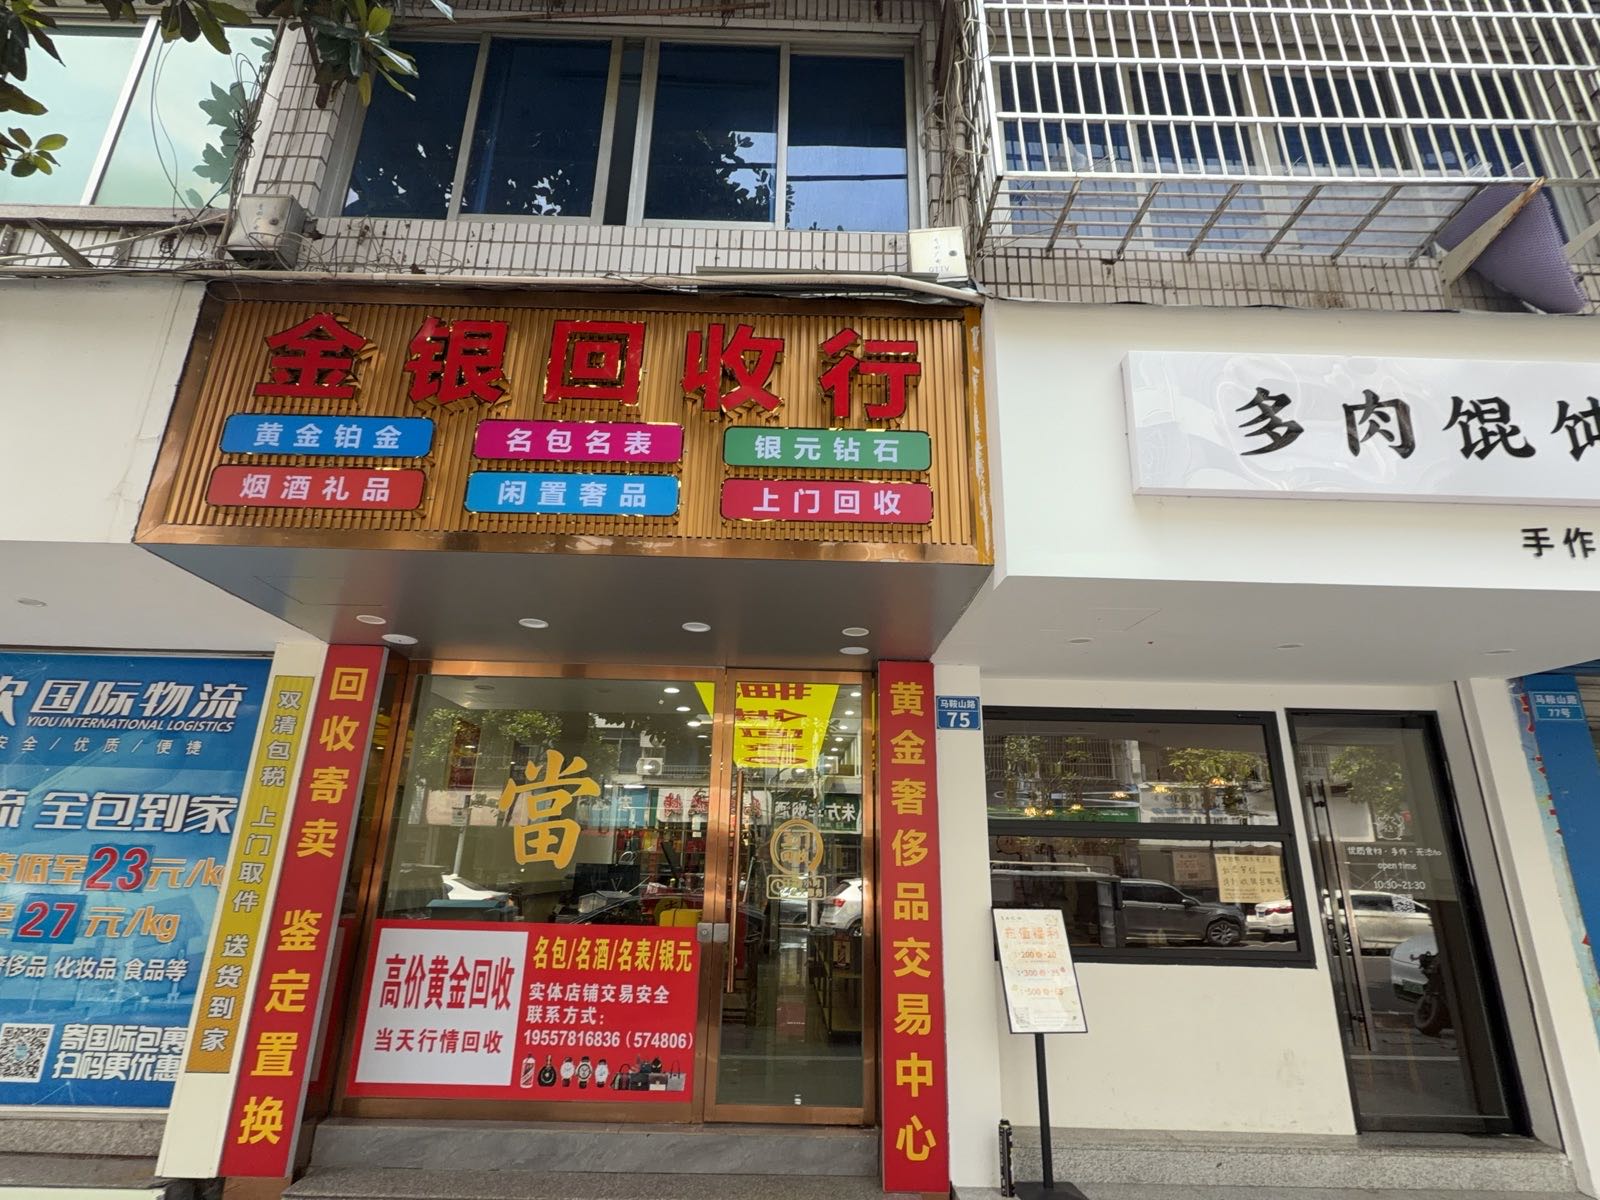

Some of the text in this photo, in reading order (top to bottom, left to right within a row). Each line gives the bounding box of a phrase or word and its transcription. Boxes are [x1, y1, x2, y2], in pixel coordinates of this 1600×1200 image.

[254, 312, 922, 420] 金银回收行
[253, 422, 402, 450] 黄金铂金
[505, 428, 652, 456] 名包名表
[755, 435, 900, 463] 银元钻石
[240, 473, 391, 503] 烟酒礼品
[498, 480, 647, 509] 闲置奢品
[753, 487, 901, 516] 上门回收
[940, 699, 976, 709] 马鞍山路
[1547, 707, 1571, 718] 77号
[26, 716, 235, 733] YIOU INTERNATIONAL LOGISTICS
[947, 711, 970, 728] 75
[34, 791, 239, 834] 全包到家
[498, 749, 601, 870] 當
[201, 689, 301, 1052] 双清包税 上门取件 送货到家
[238, 667, 369, 1146] 回收寄卖 鉴定置换
[889, 681, 937, 1163] 黄金奢侈品交易中心
[533, 935, 694, 973] 名包/名酒/名表/银元
[0, 956, 189, 983] 侈品 化妆品 食品等
[379, 953, 516, 1012] 高价黄金回收
[528, 981, 670, 1005] 实体店铺交易安全
[60, 1023, 189, 1054] 寄国际包裹
[374, 1026, 504, 1055] 当天行情回收
[52, 1051, 183, 1082] 扫码更优惠
